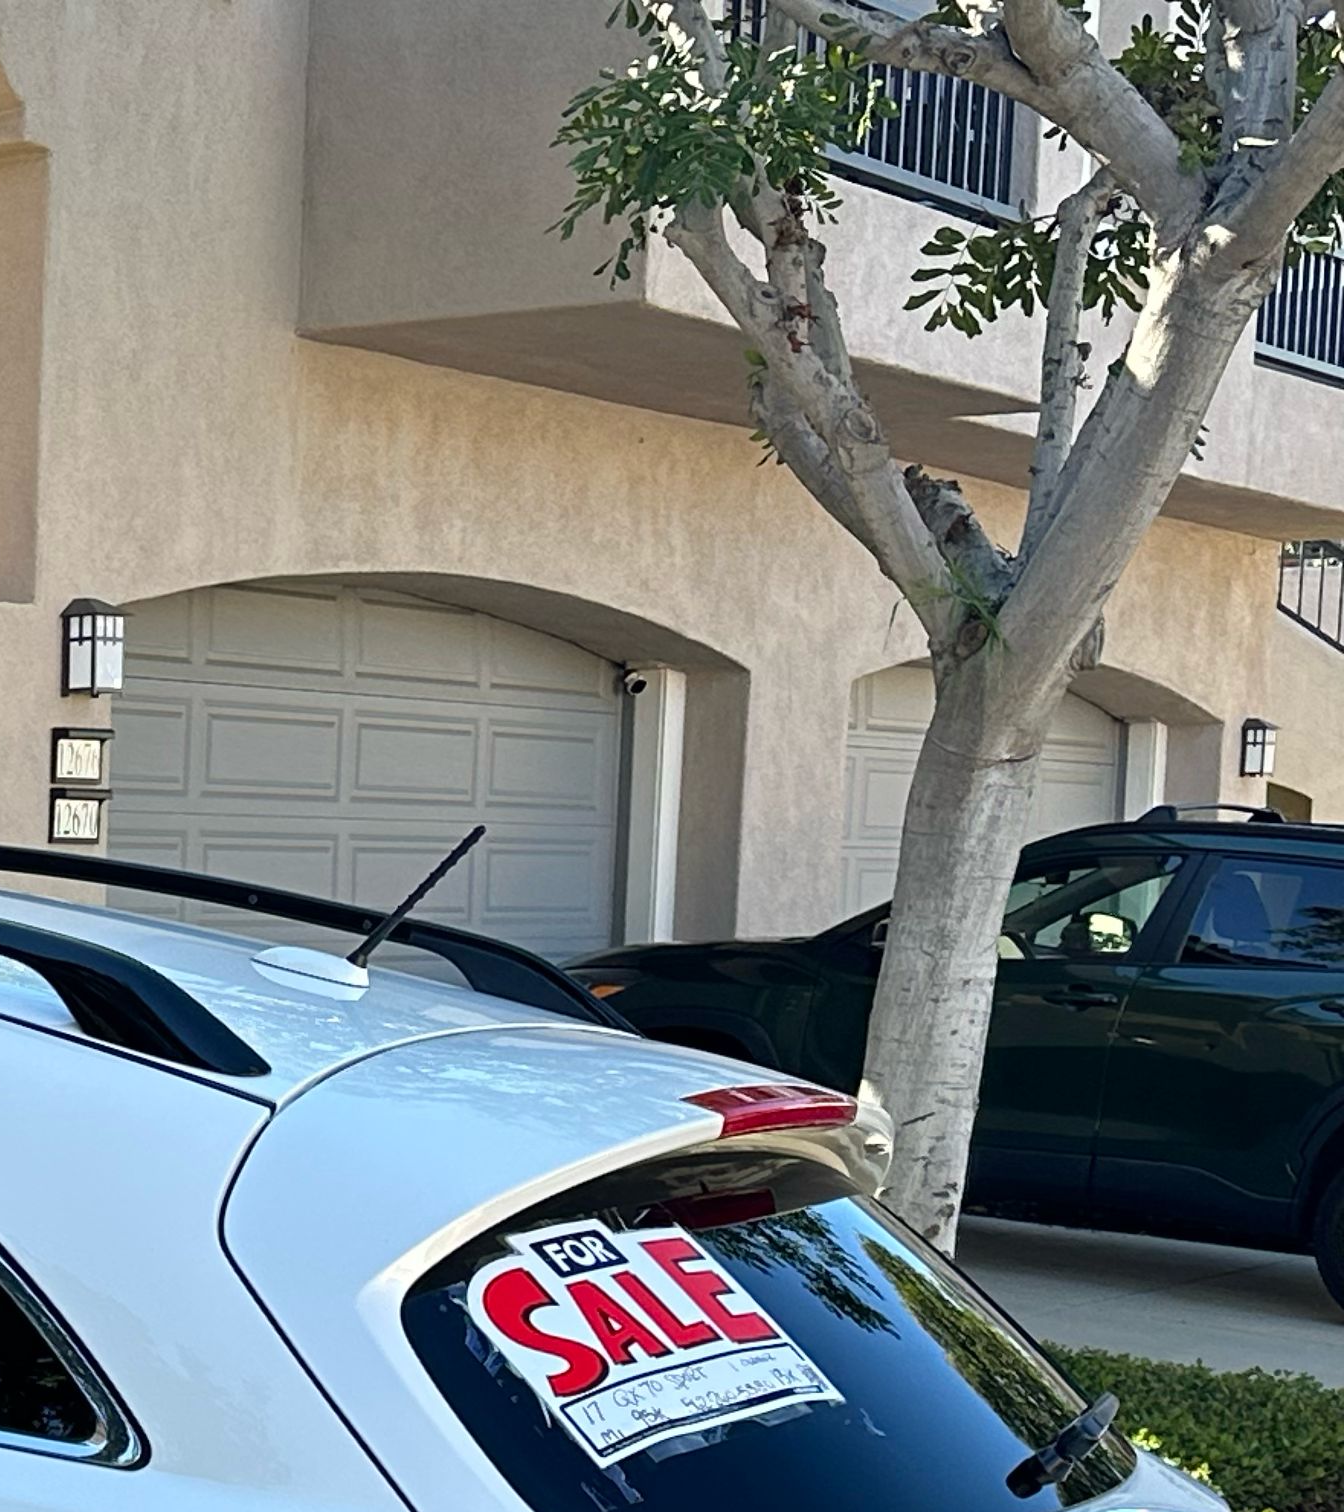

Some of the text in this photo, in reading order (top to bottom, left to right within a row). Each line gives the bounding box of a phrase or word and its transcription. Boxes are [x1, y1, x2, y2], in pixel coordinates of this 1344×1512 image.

[542, 1236, 622, 1272] FOR
[482, 1237, 782, 1398] SALE
[582, 1401, 606, 1425] 17
